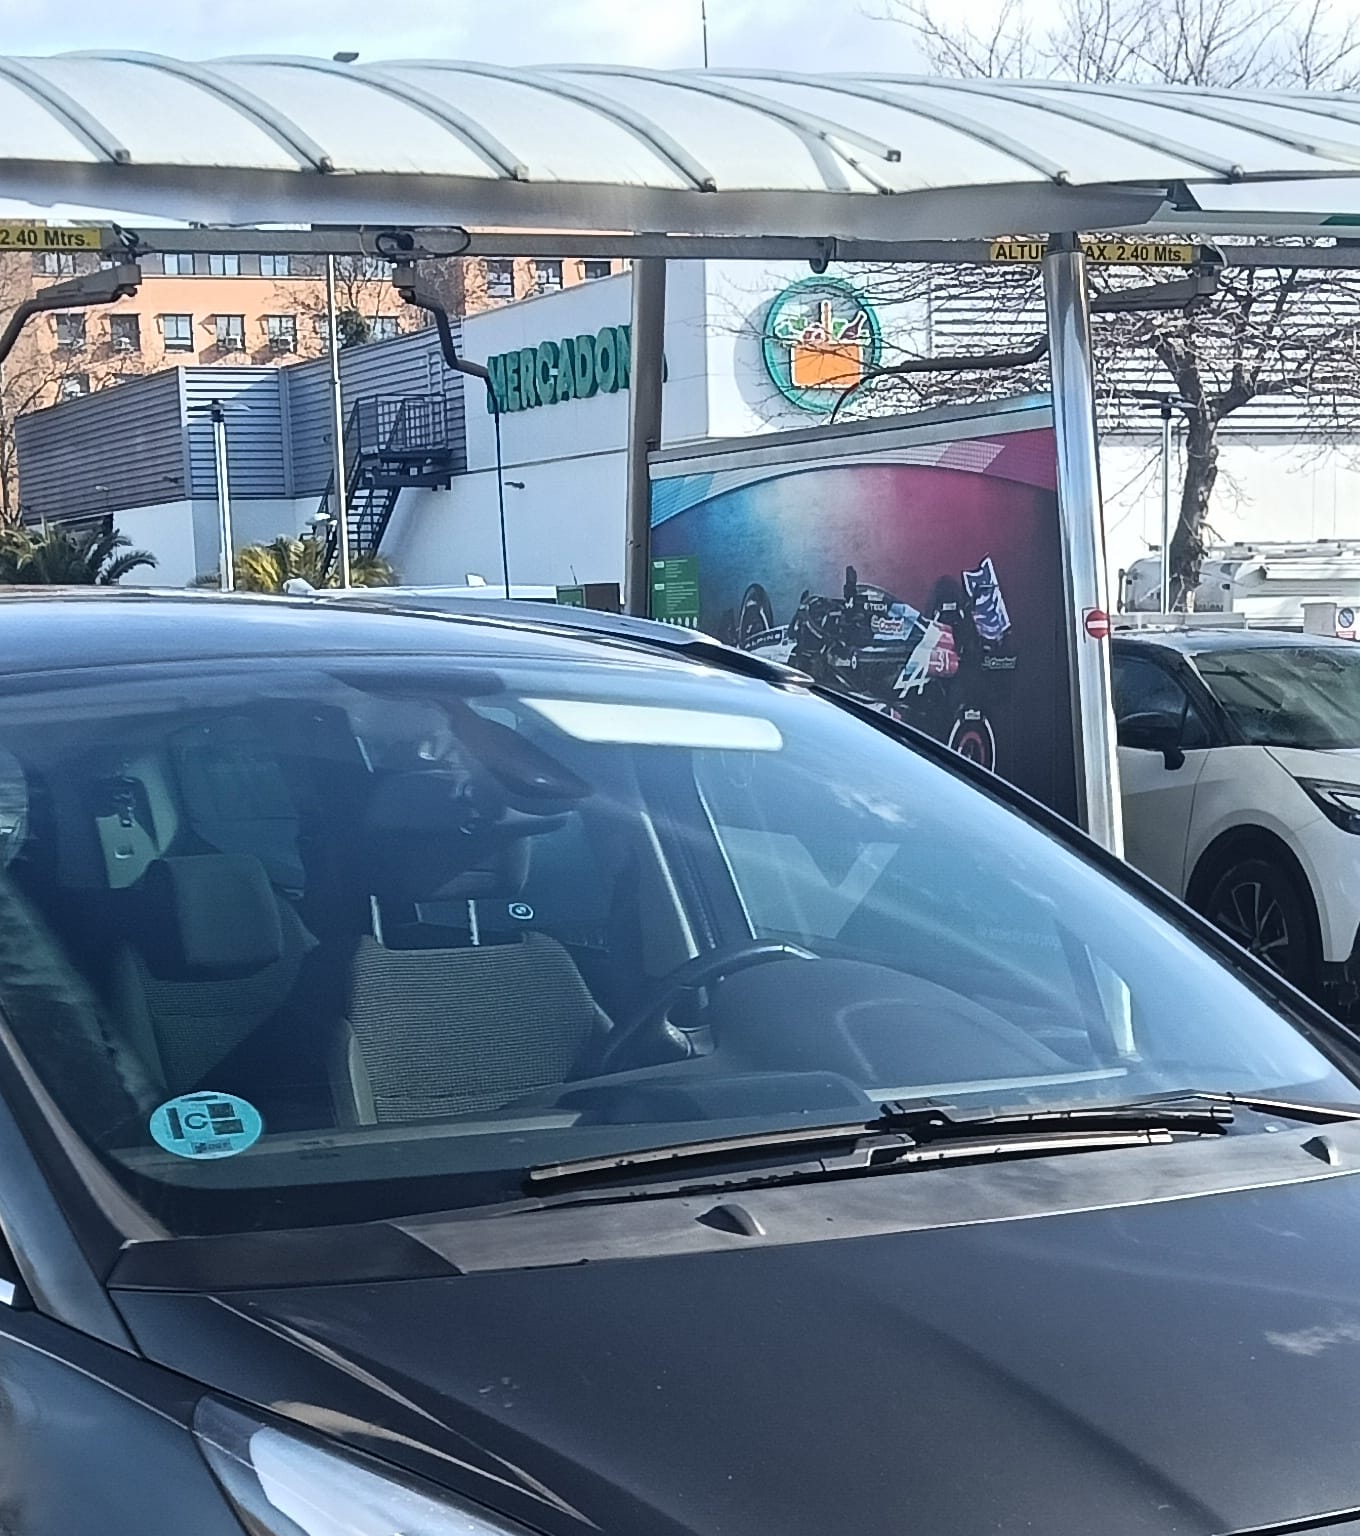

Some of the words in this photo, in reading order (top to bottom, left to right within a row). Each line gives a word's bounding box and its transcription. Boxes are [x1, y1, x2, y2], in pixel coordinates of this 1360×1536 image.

[0, 229, 38, 246] 2.40
[44, 230, 90, 247] Mtrs.
[1116, 246, 1149, 261] 2.40
[1154, 246, 1186, 262] Mts.
[487, 325, 632, 414] MERCADON
